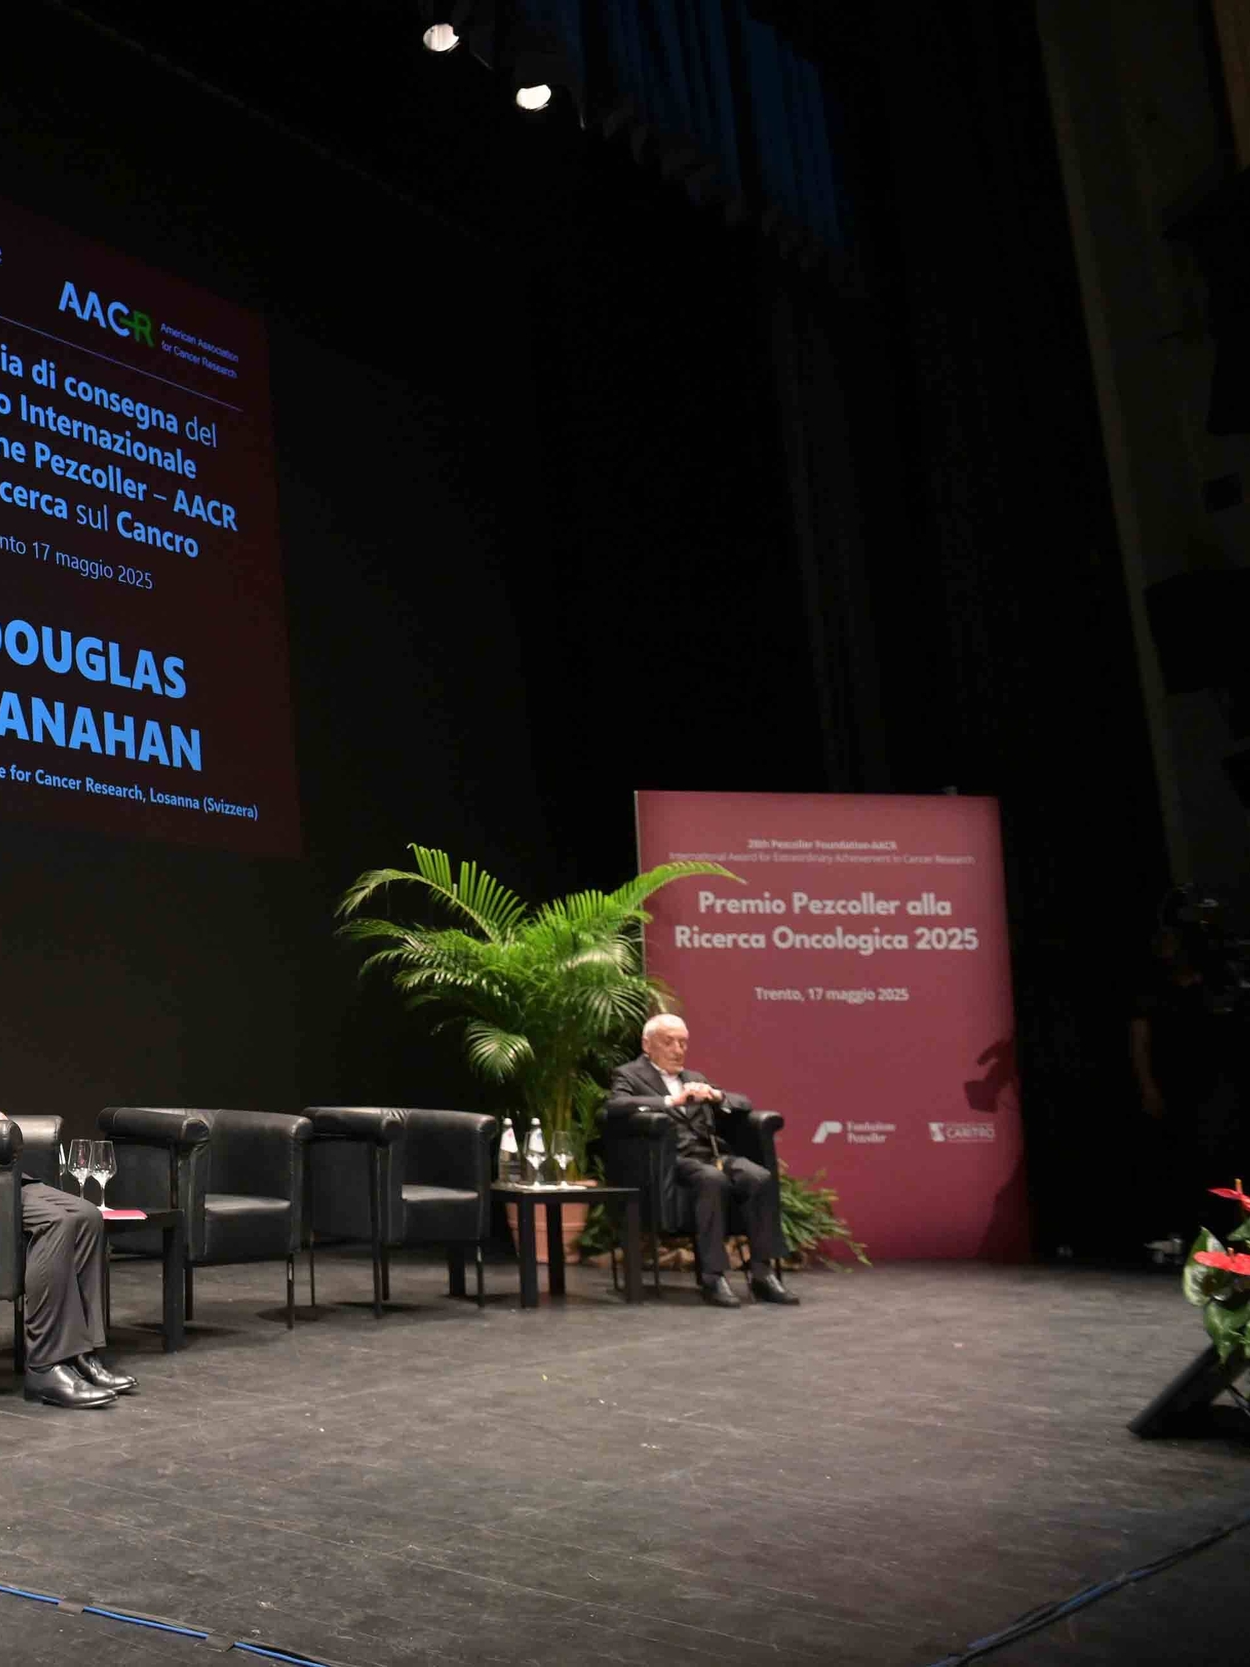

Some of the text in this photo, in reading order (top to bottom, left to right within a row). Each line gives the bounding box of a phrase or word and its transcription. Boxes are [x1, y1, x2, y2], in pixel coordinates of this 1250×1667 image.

[58, 281, 154, 348] AACR
[160, 323, 239, 363] American Association
[161, 340, 238, 379] for Cancer Research
[31, 356, 56, 389] di
[64, 376, 178, 436] consegna
[185, 415, 217, 449] del
[20, 395, 197, 479] Internazionale
[35, 440, 147, 502] Pezcoller
[173, 489, 238, 532] AACR
[77, 503, 109, 532] sul
[116, 511, 199, 558] Cancro
[32, 542, 51, 562] 17
[56, 549, 113, 583] maggio
[118, 565, 153, 590] 2025
[10, 764, 32, 783] for
[35, 769, 81, 791] Cancer
[85, 778, 146, 804] Research,
[150, 788, 200, 810] Losanna
[203, 796, 258, 822] (Svizzera)
[698, 891, 952, 916] Premio Pezcoller alla
[675, 926, 978, 955] Ricerca Oncologica 2025
[754, 987, 909, 1004] Trento, 17 maggio 2025
